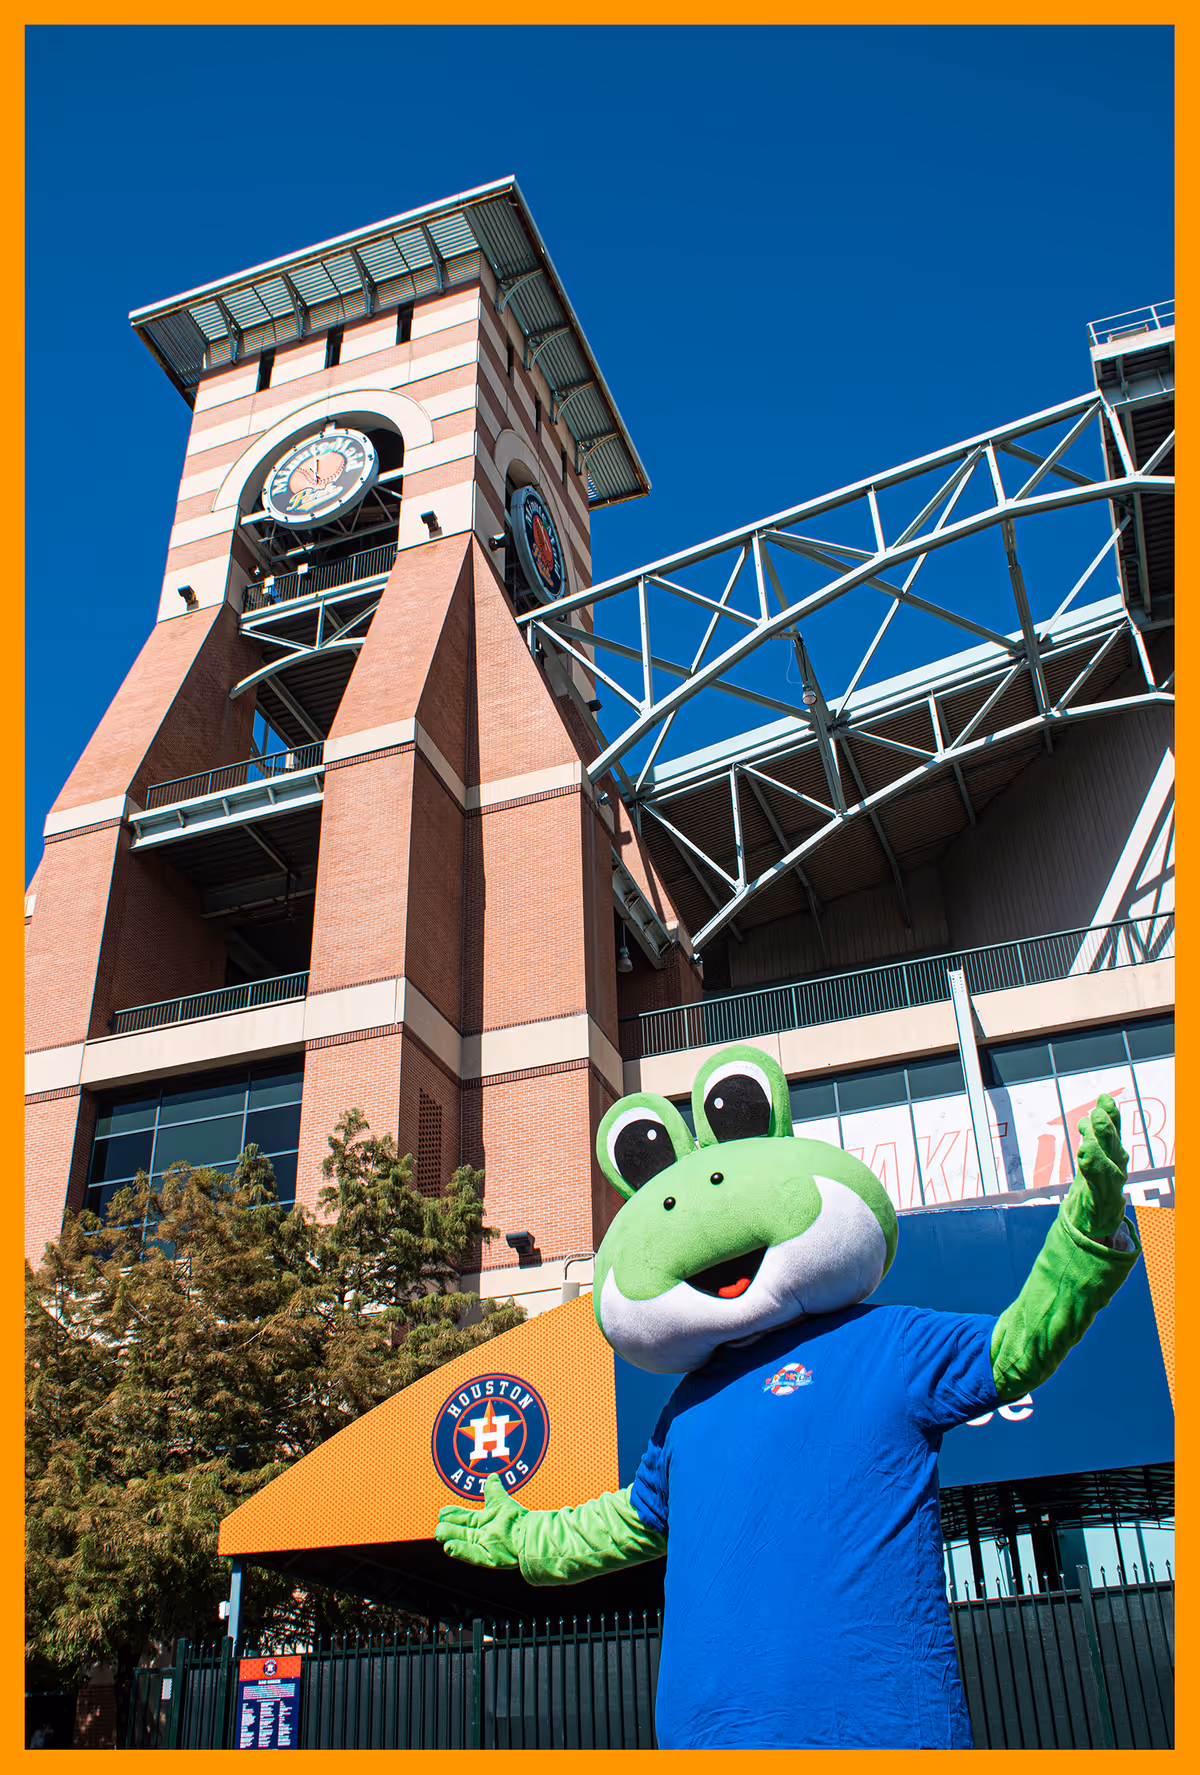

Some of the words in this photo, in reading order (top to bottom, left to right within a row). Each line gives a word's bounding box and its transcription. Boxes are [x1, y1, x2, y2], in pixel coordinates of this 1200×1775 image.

[272, 442, 330, 496] Minute
[330, 437, 364, 473] Maid
[286, 481, 340, 512] Park
[447, 1380, 533, 1418] HOUSTON
[470, 1414, 510, 1460] H
[450, 1460, 529, 1494] ASTOS
